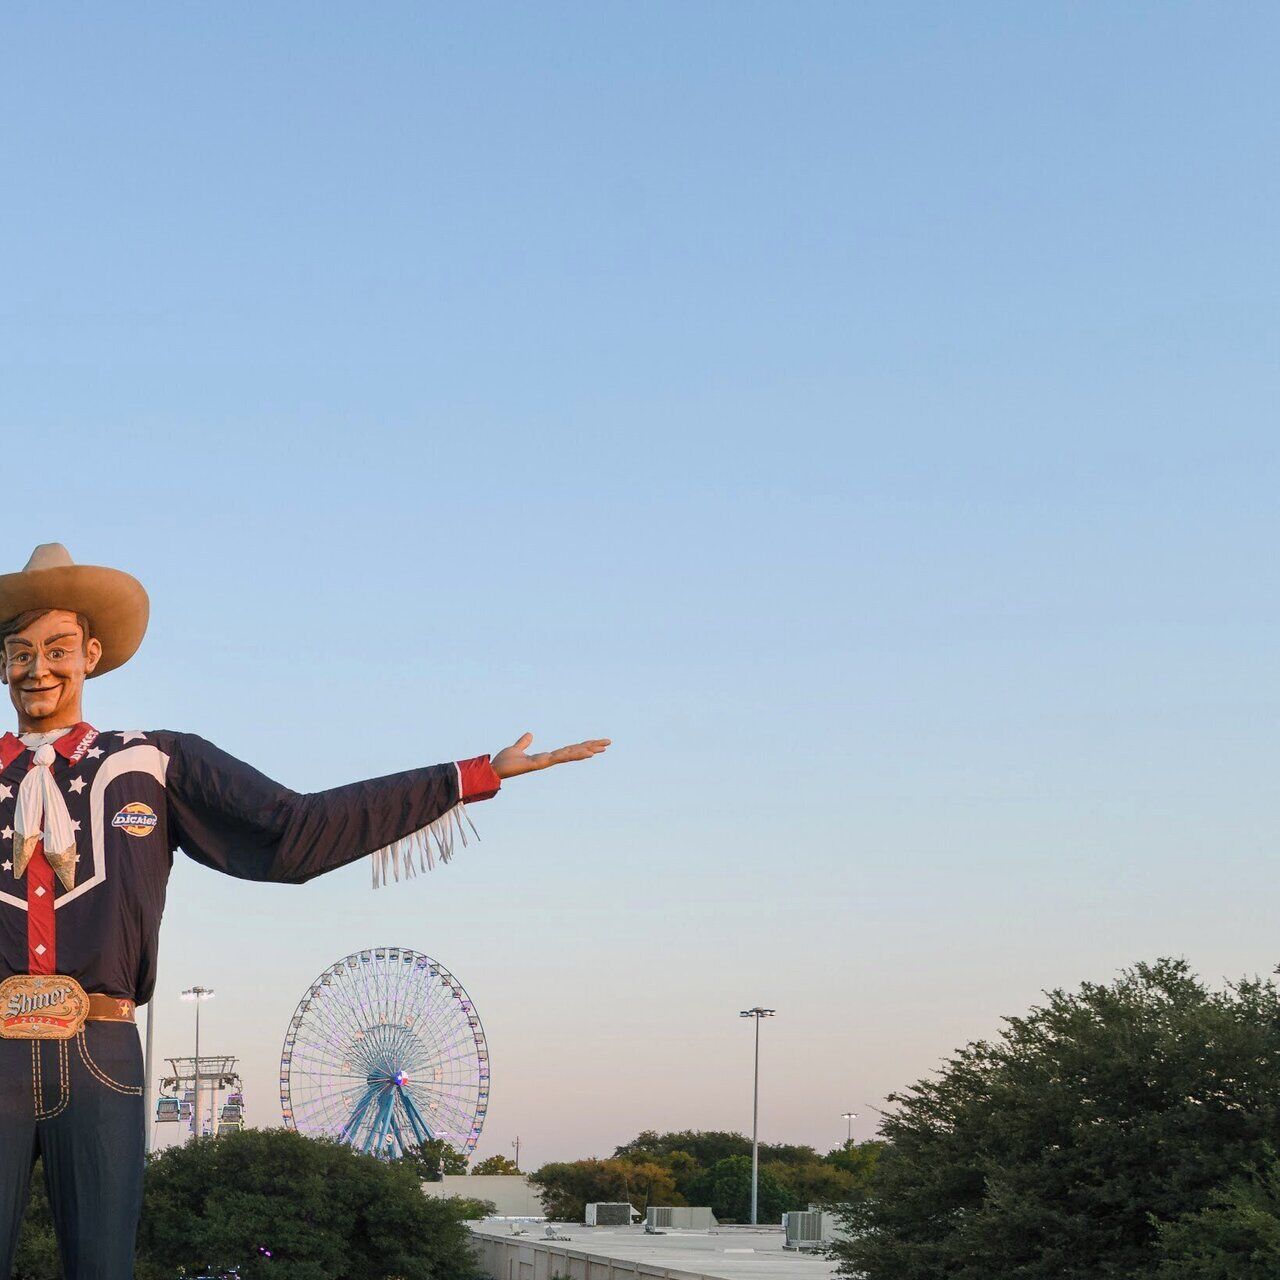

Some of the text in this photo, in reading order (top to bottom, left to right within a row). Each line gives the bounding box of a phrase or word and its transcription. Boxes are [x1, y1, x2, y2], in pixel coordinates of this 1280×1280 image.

[70, 729, 99, 761] DICKIES
[6, 984, 72, 1018] Shiner
[21, 1016, 51, 1025] 2022
